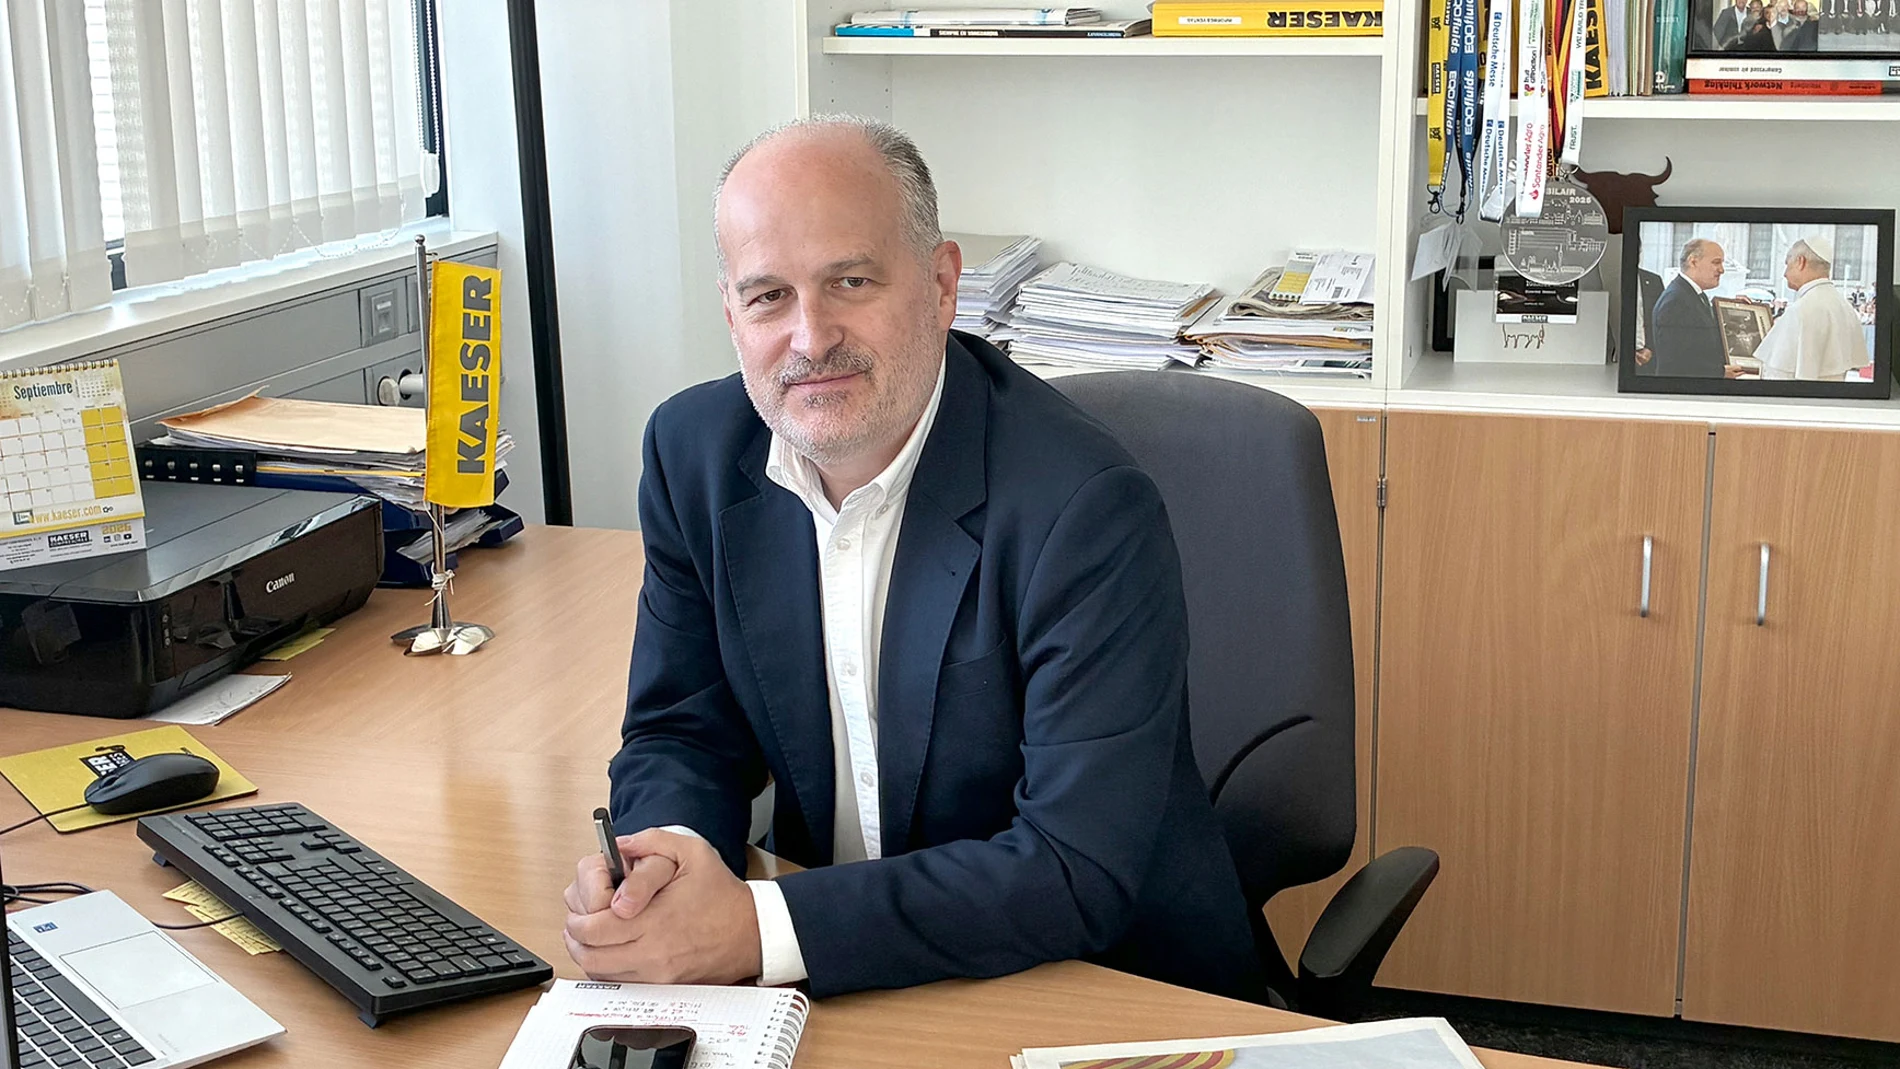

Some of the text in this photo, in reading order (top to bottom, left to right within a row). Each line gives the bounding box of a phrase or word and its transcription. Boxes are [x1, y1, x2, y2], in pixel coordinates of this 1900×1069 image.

[1267, 10, 1383, 29] KAESER
[1450, 0, 1462, 54] QOfluids
[1489, 21, 1502, 87] Deutsche Messe
[1585, 0, 1602, 90] KAES
[1750, 66, 1782, 74] Compressed
[1705, 80, 1743, 90] Thinking
[1744, 81, 1783, 90] Network
[1446, 71, 1457, 135] EQOfluids
[1464, 70, 1475, 135] EQOfluids
[1483, 128, 1492, 166] Deutsche
[1532, 145, 1543, 188] Santander
[1546, 187, 1576, 196] BILAIR
[457, 275, 492, 474] KAESER
[14, 380, 73, 401] Septiembre
[49, 531, 88, 544] KAESER
[265, 572, 295, 593] Canon
